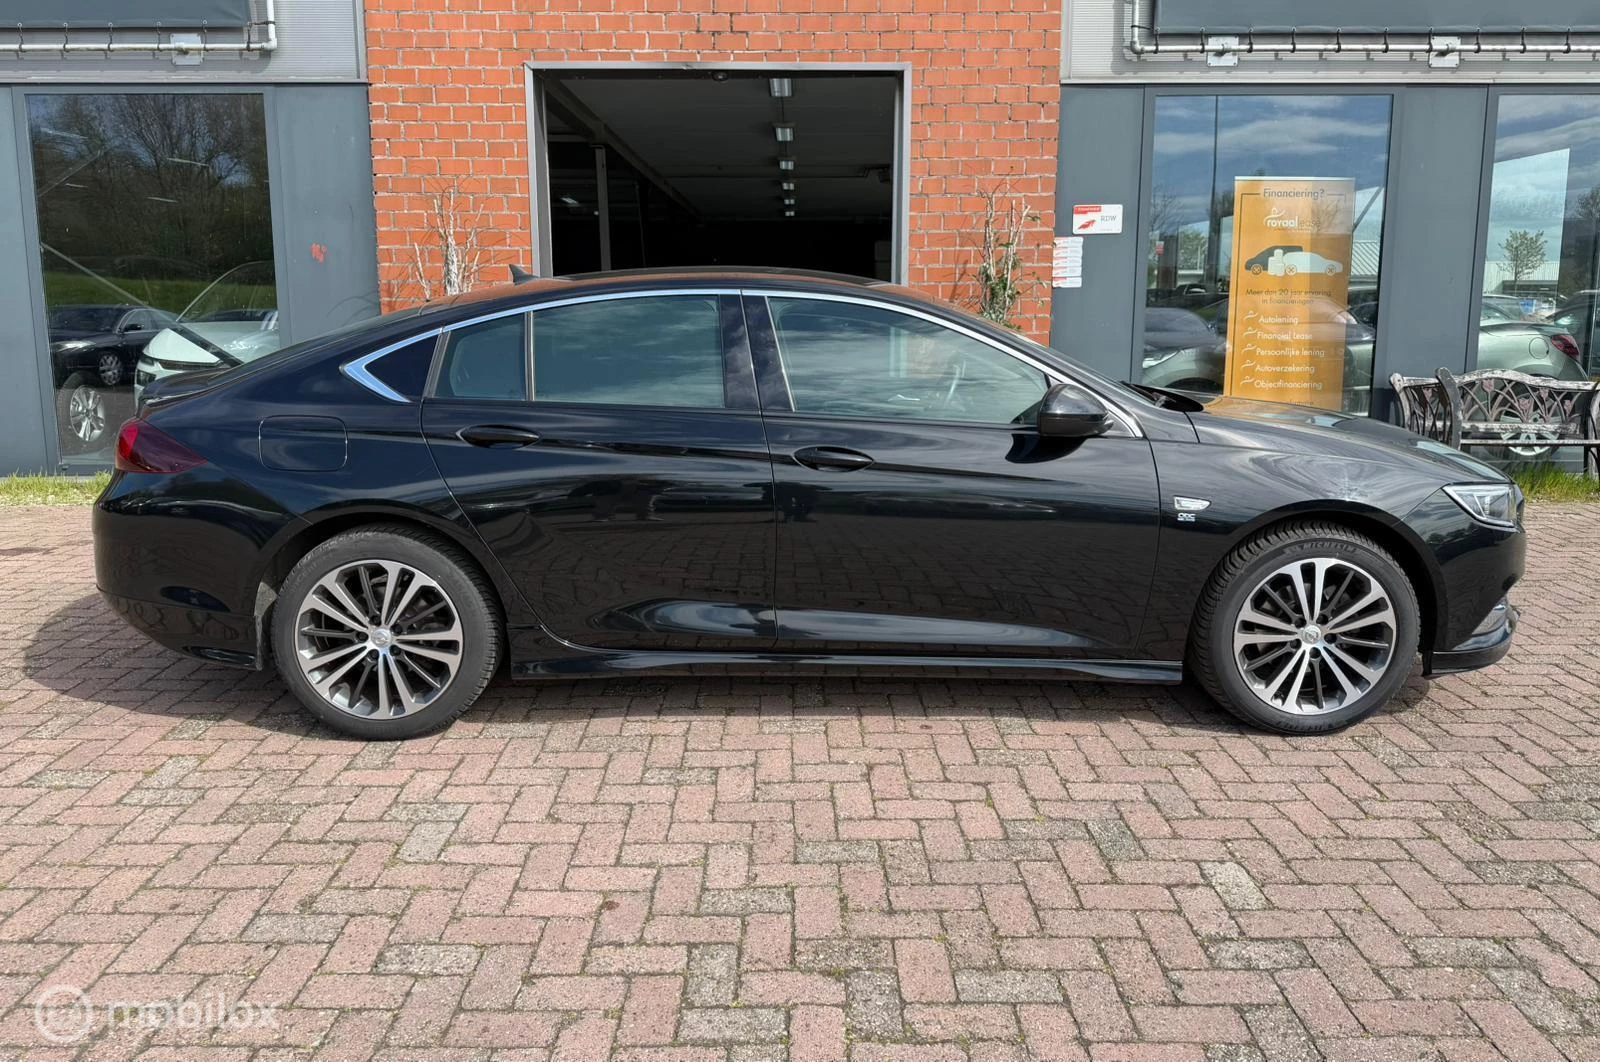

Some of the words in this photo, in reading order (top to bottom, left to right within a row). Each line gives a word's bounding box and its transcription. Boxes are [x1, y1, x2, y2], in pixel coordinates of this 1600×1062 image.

[1263, 188, 1325, 200] Financiering?
[1279, 288, 1289, 296] 20
[1258, 315, 1299, 325] Autolening
[1257, 331, 1292, 340] Financial
[1293, 331, 1313, 340] Lease
[1256, 348, 1300, 358] Persoonlijke
[1301, 348, 1325, 358] lening
[1255, 364, 1315, 374] Autoverzekering
[1254, 380, 1323, 390] Objectfinanciering
